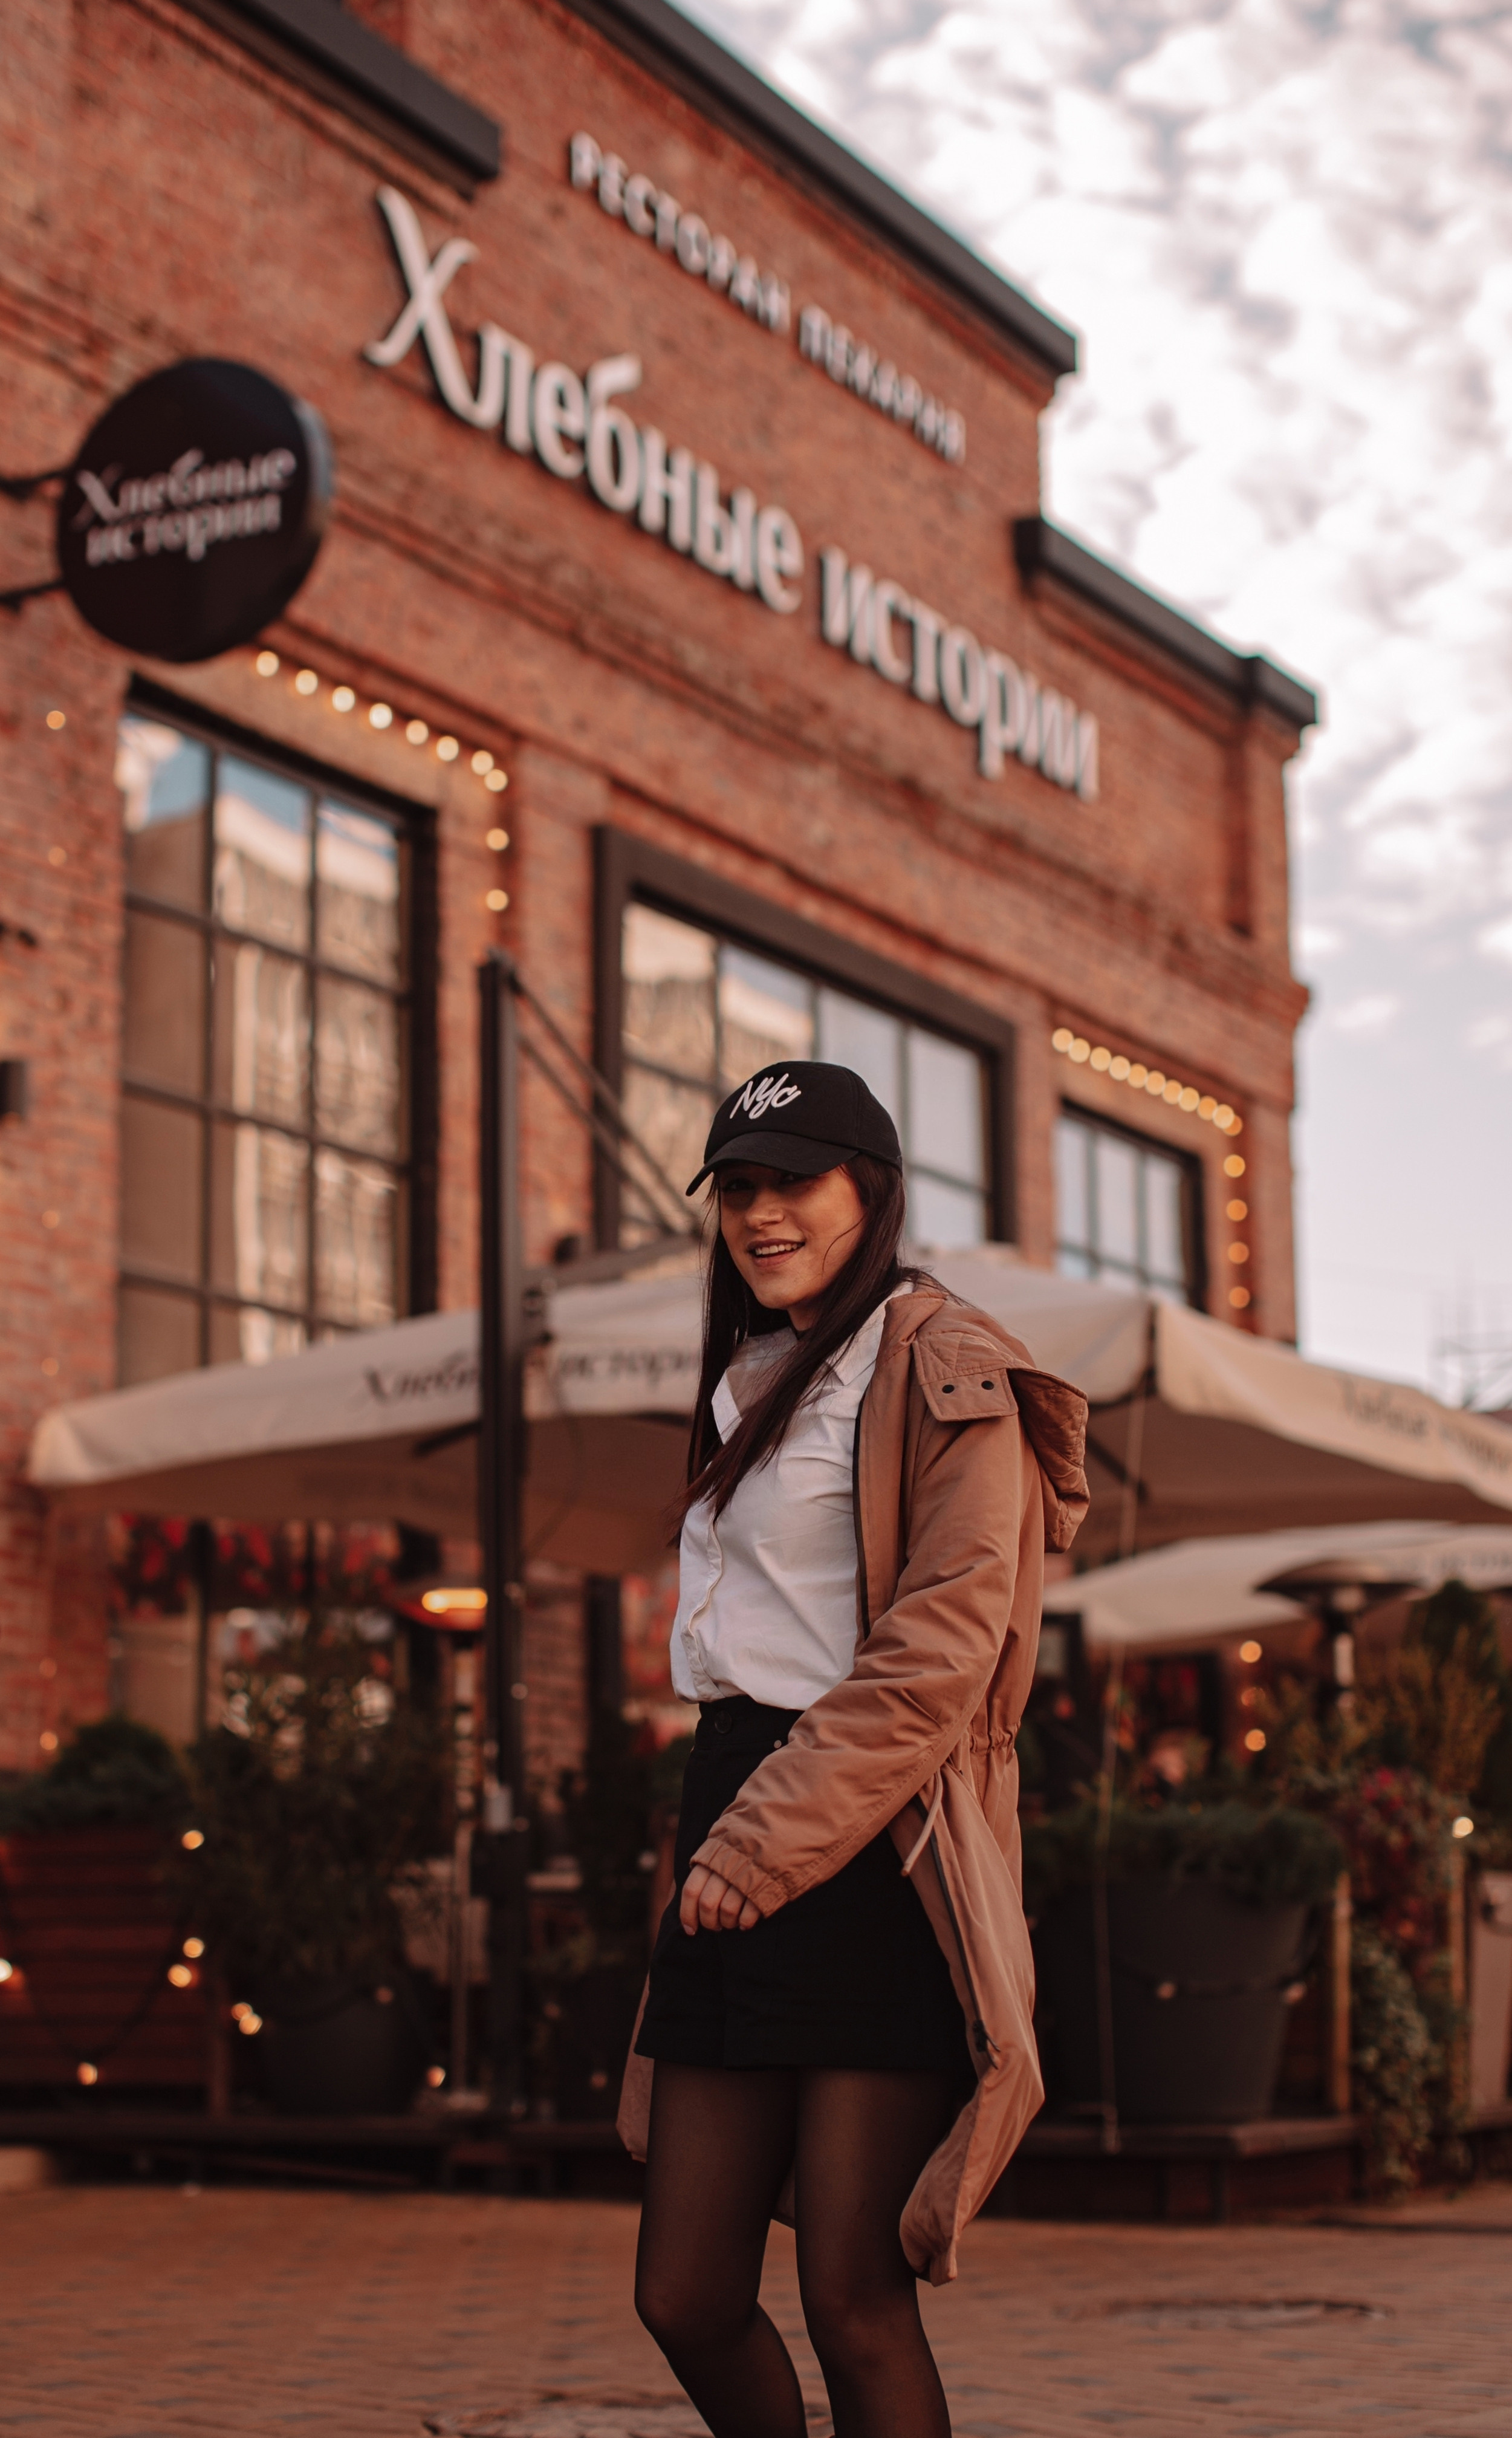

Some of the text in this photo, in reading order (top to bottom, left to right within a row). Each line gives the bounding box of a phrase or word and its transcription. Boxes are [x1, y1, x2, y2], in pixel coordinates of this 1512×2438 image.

[570, 131, 966, 464] РЕСТОРАН ПЕКАРНЯ
[74, 447, 296, 530] Хлебные
[365, 186, 1098, 799] Хлебные истории
